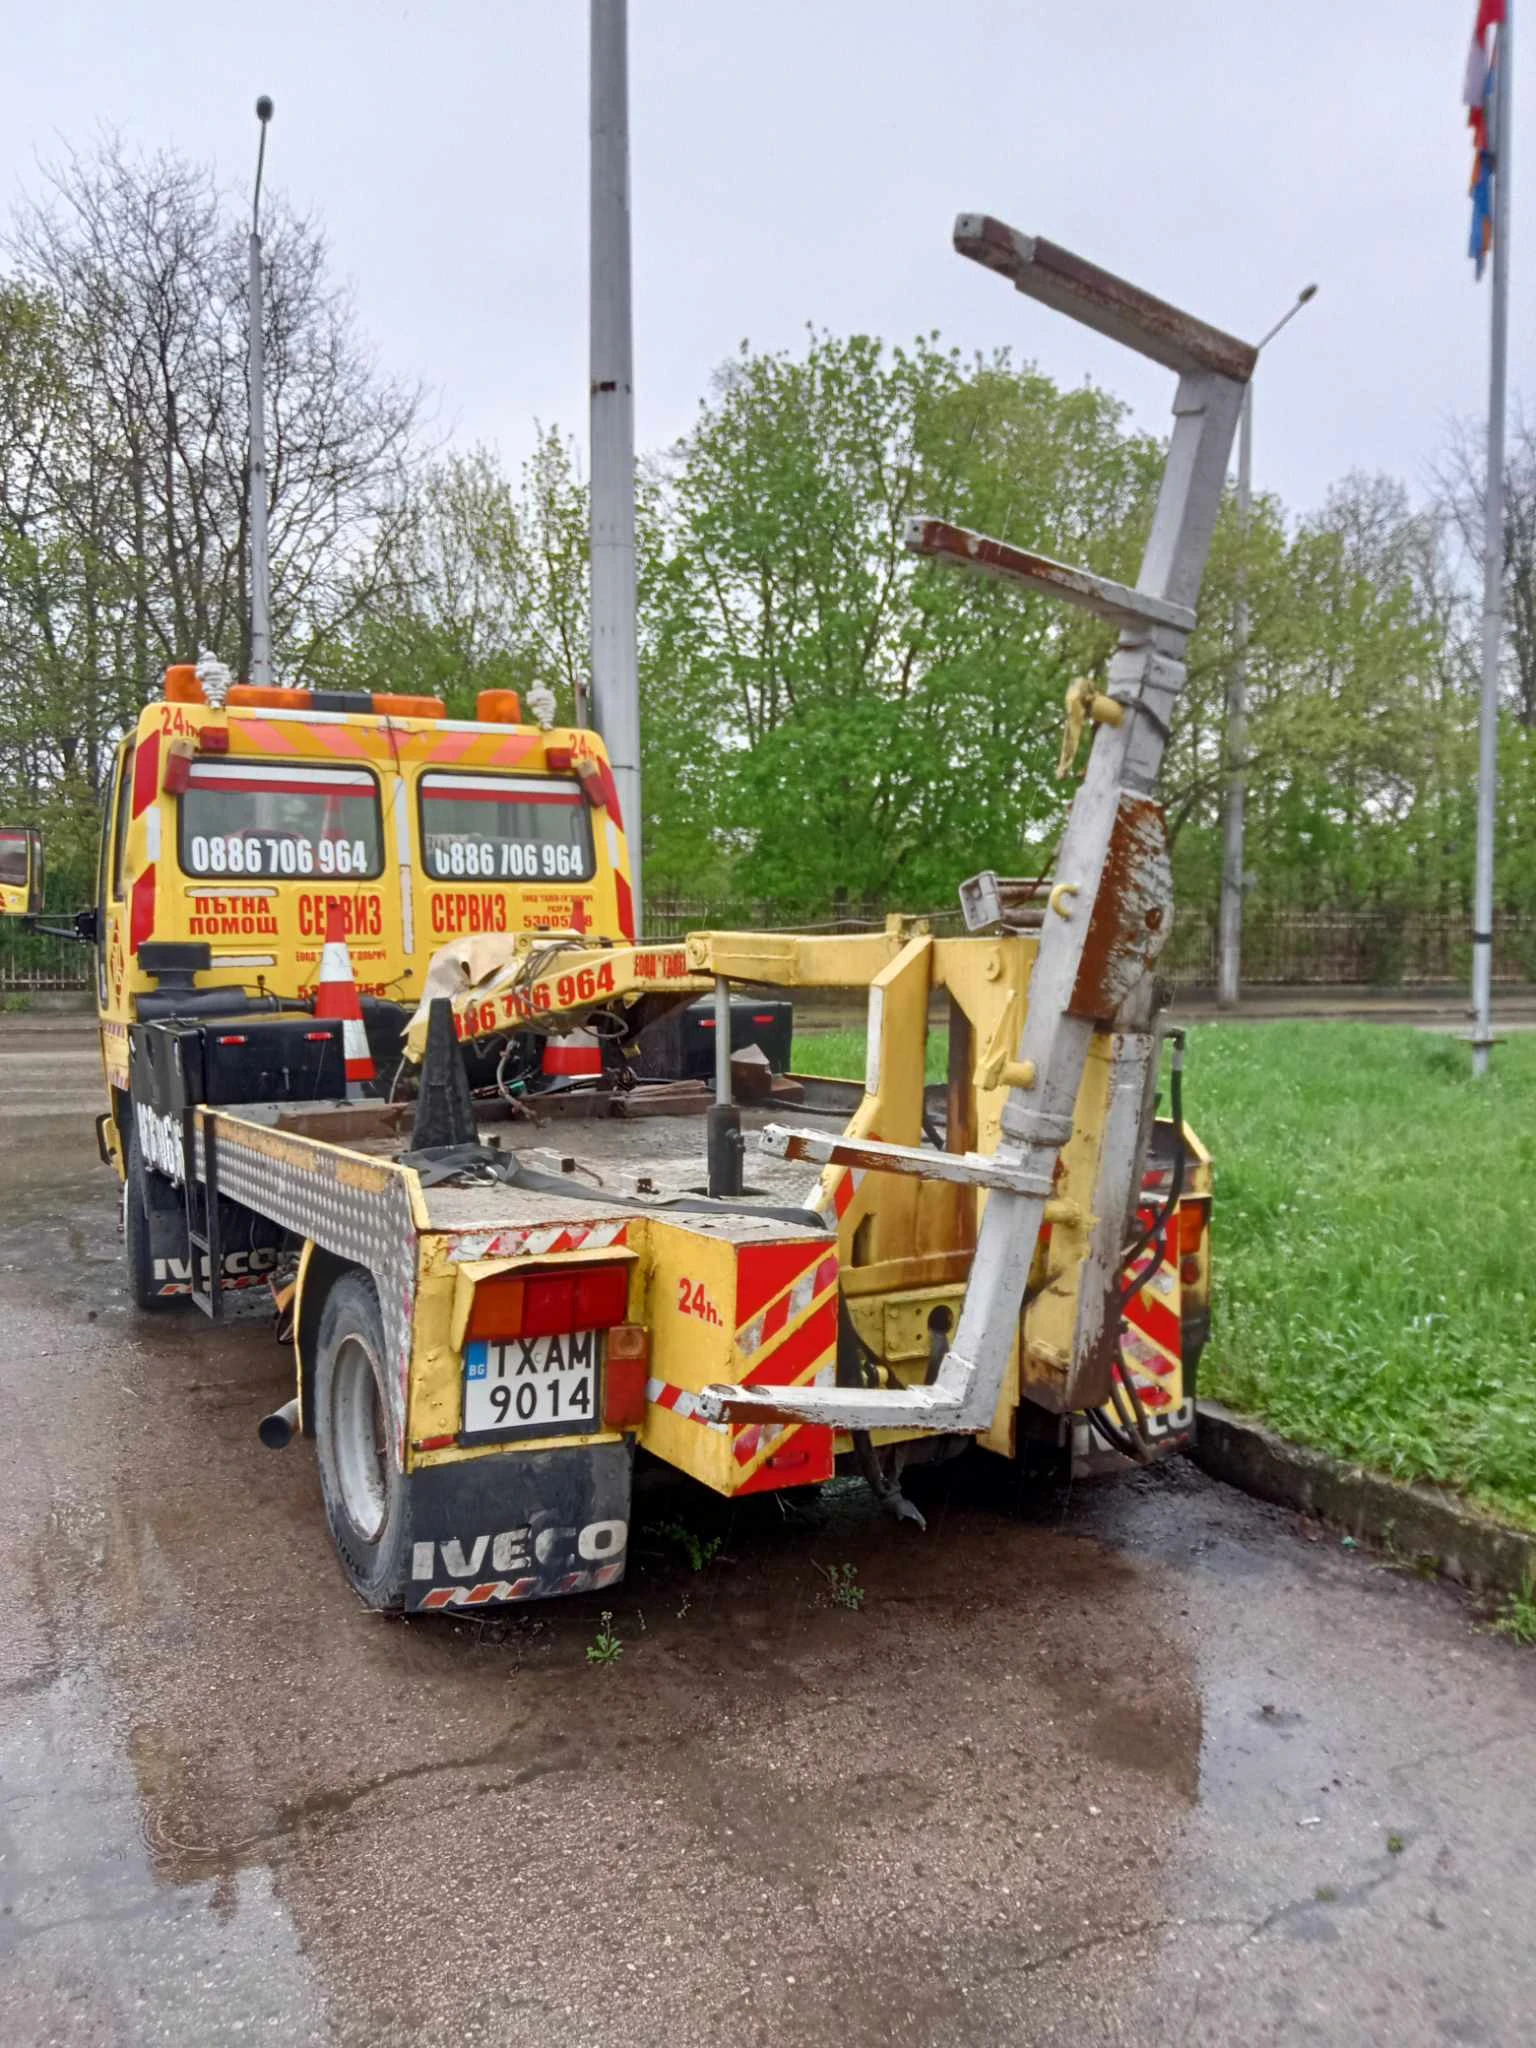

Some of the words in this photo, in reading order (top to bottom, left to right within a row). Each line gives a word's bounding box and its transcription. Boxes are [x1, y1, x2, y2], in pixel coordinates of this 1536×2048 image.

[191, 835, 262, 873] 0886
[265, 838, 313, 874] 706
[318, 839, 367, 874] 964
[542, 844, 583, 876] 964
[195, 896, 270, 914] ПЪТНА
[431, 893, 507, 933] СЕРВИЗ
[522, 914, 593, 929] 530058
[189, 917, 279, 936] ПОМОЩ
[557, 961, 616, 1006] 964
[679, 1278, 723, 1327] 24h.
[469, 1365, 485, 1376] BG
[489, 1376, 591, 1424] 9014
[412, 1520, 628, 1580] IVECO
